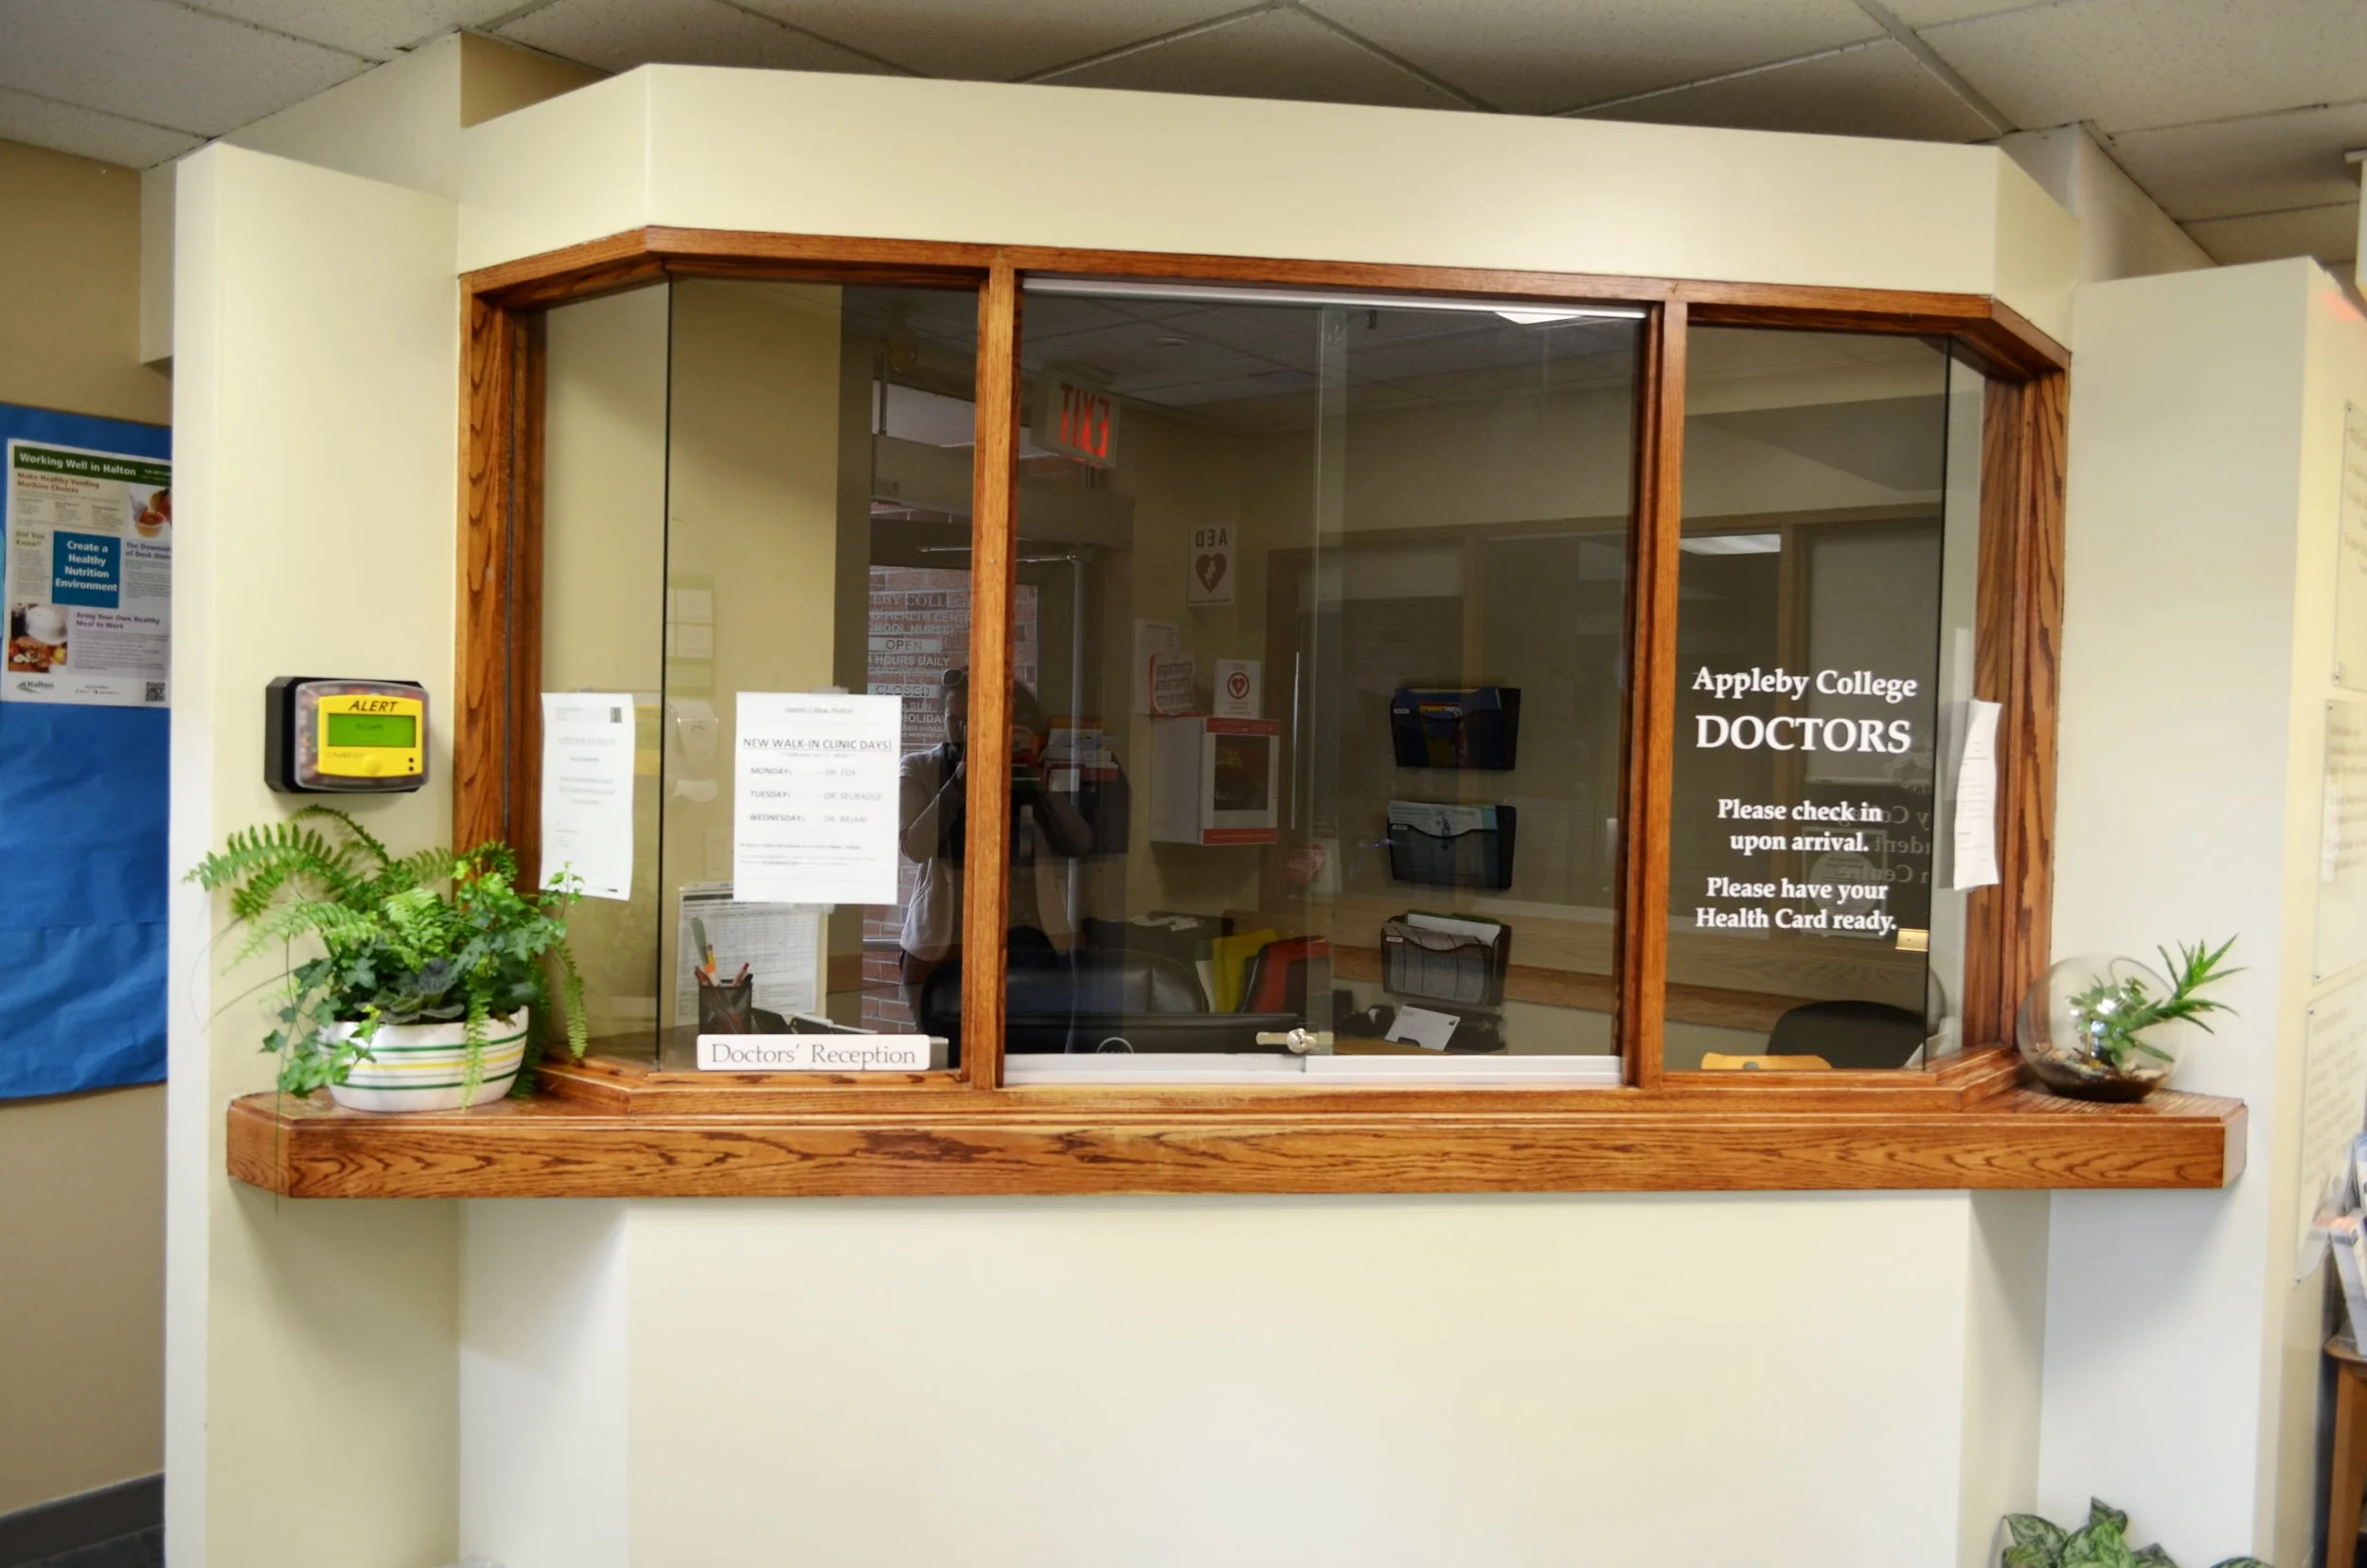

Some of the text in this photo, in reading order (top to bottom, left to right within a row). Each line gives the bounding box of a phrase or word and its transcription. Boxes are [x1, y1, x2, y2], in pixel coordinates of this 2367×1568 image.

[19, 453, 63, 470] Working
[66, 458, 88, 471] Well
[90, 461, 100, 472] in
[103, 463, 136, 476] Halton
[41, 474, 69, 485] Healthy
[70, 477, 100, 490] Vending
[66, 541, 109, 553] Create a
[67, 554, 107, 567] Healthy
[64, 566, 110, 579] Nutrition
[54, 579, 118, 593] Environment
[133, 615, 161, 626] Healthy
[886, 640, 922, 651] OPEN
[876, 655, 951, 667] HOURS DAILY
[876, 685, 930, 697] CLOSED
[1692, 666, 1918, 704] Appleby College
[348, 700, 400, 712] ALERT
[1695, 714, 1913, 754] DOCTORS
[743, 738, 769, 748] NEW
[772, 739, 820, 749] WALK-IN
[823, 739, 857, 750] CLINIC
[1717, 798, 1786, 822] Please
[1791, 800, 1854, 822] check
[1858, 801, 1883, 822] in
[1729, 831, 1870, 857] upon arrival.
[1705, 876, 1889, 906] Please have your
[1695, 906, 1898, 935] Health Card ready.
[811, 1044, 917, 1070] Reception
